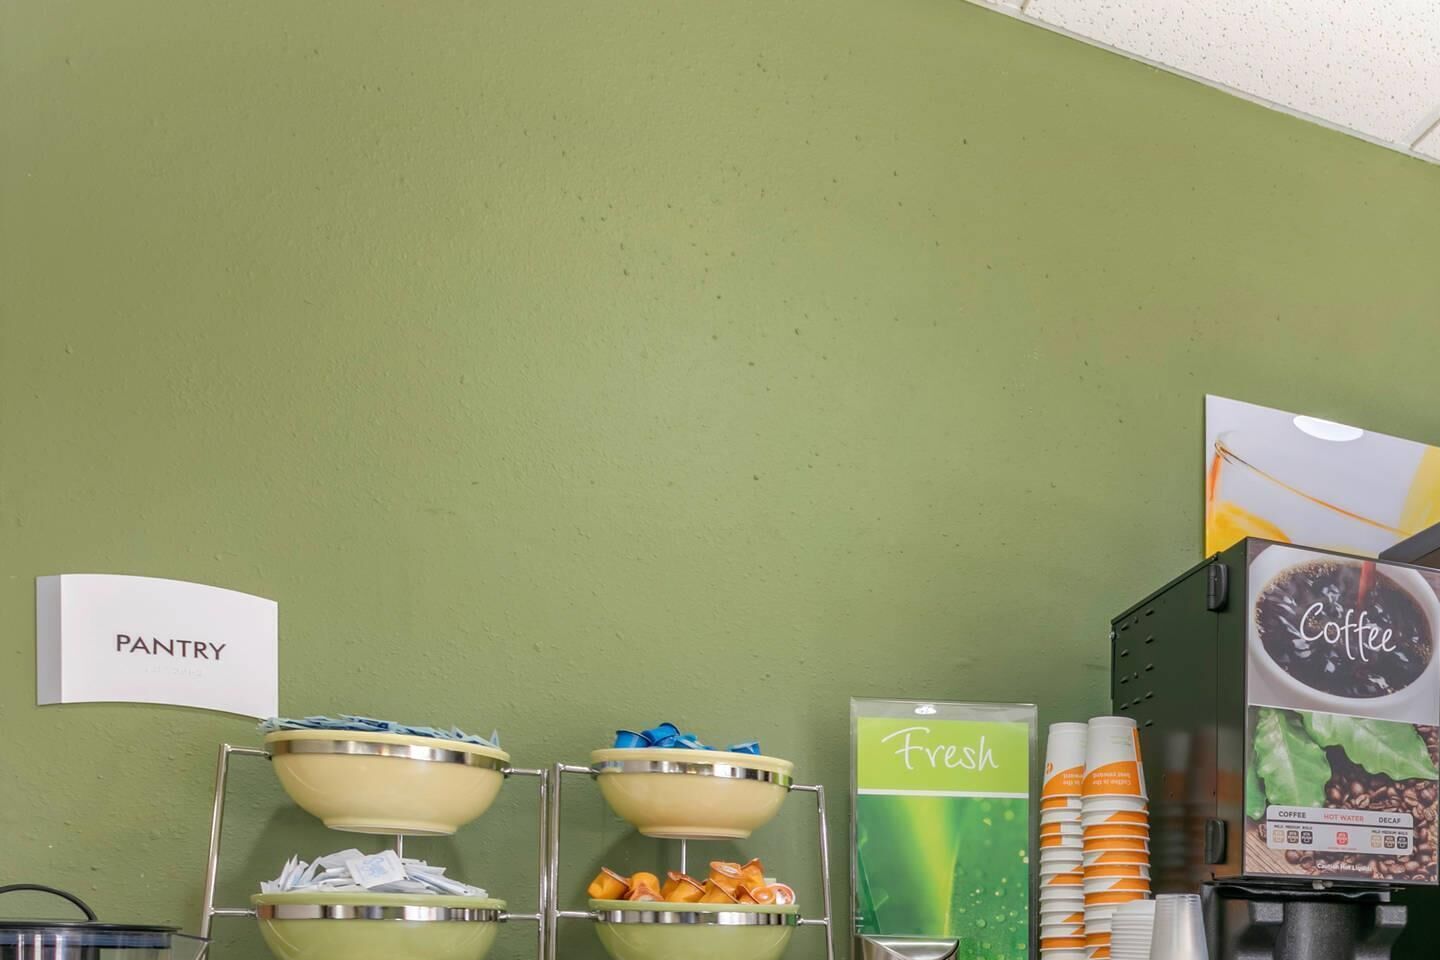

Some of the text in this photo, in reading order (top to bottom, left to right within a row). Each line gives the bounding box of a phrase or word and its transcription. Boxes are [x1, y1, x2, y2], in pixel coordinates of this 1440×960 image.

[117, 634, 226, 660] PANTRY
[1300, 602, 1397, 662] Coffee
[881, 727, 999, 771] Fresh
[1279, 811, 1307, 819] COFFEE
[1340, 815, 1365, 823] WATER
